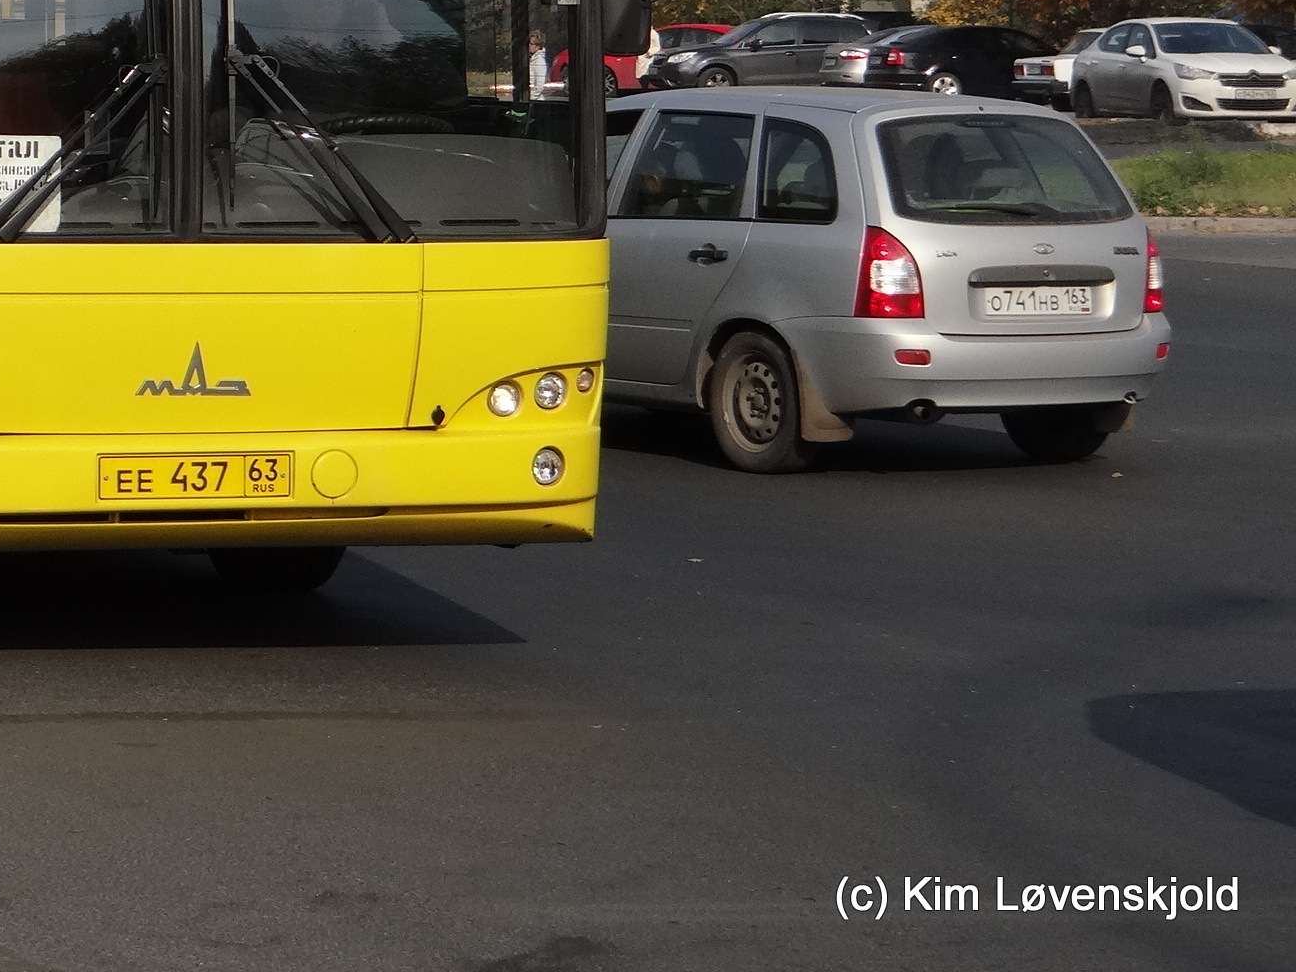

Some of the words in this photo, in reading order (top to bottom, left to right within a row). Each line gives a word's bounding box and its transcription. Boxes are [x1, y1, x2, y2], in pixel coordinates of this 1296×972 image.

[1063, 288, 1087, 305] 163
[170, 461, 229, 493] 437
[248, 458, 278, 482] 63
[252, 483, 275, 493] RUS
